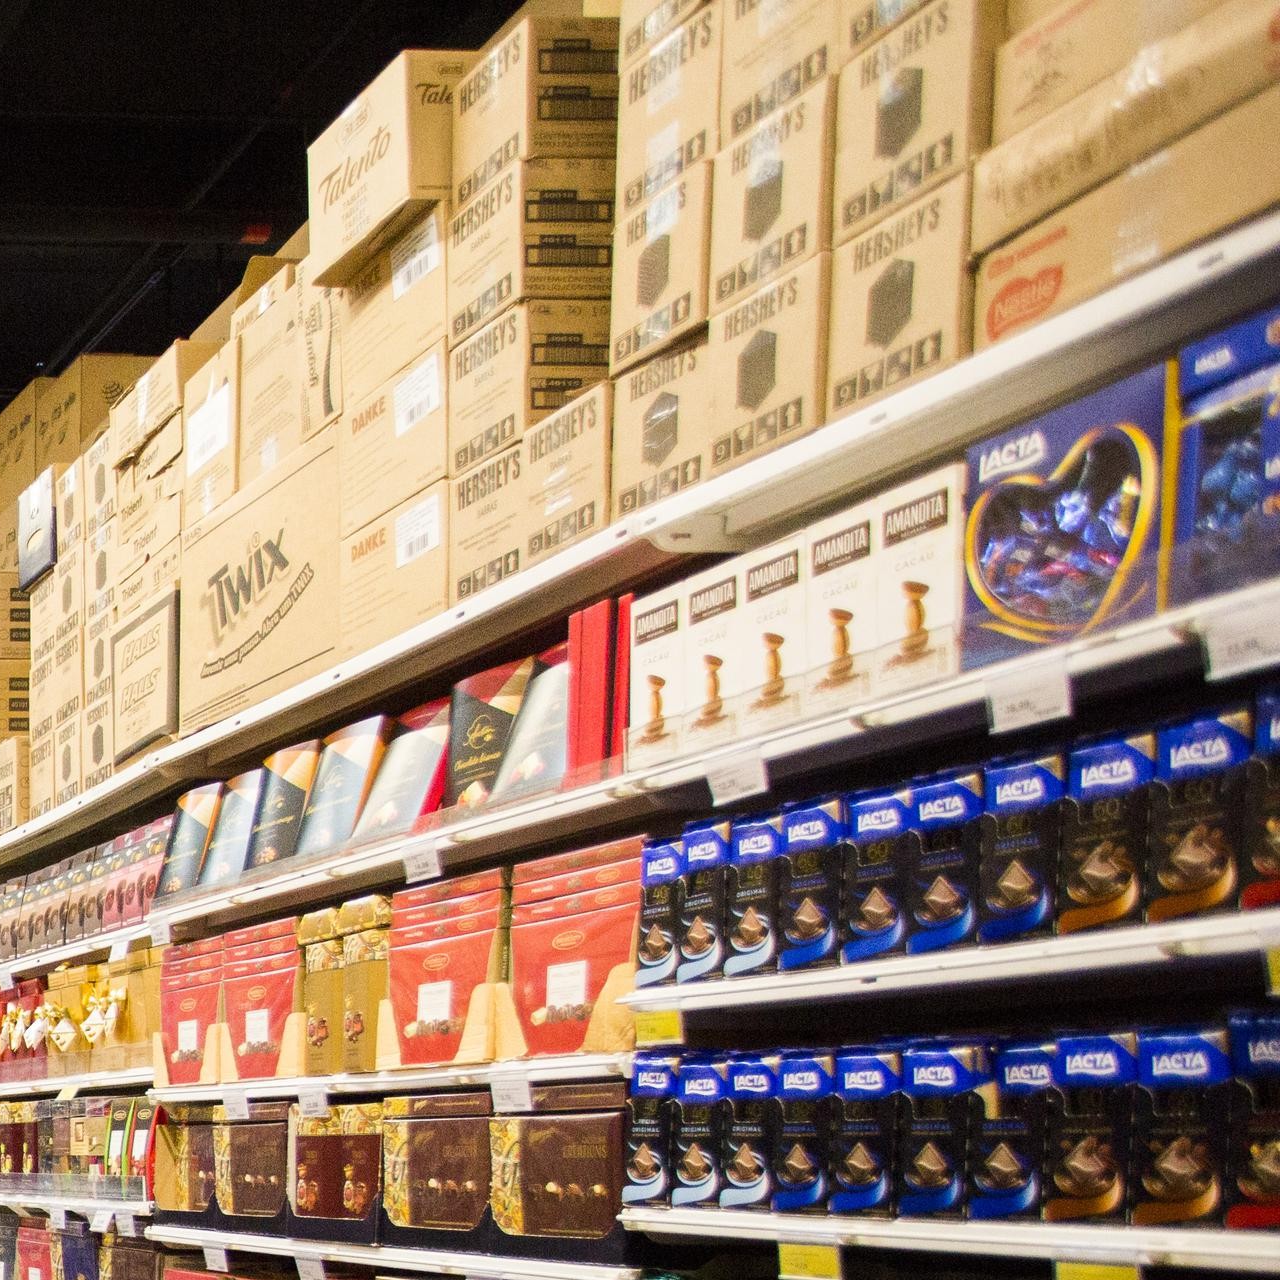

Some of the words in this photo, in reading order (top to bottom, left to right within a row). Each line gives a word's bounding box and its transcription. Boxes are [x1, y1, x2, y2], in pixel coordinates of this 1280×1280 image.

[459, 33, 521, 114] HERSHEY'S
[416, 82, 452, 106] Tale
[319, 125, 392, 214] Talento
[452, 176, 514, 255] HERSHEY'S
[853, 198, 941, 275] HERSHEY'S
[455, 314, 517, 382] HERSHEY'S
[630, 347, 697, 401] HERSHEY'S
[351, 396, 386, 434] DANKE
[529, 396, 597, 464] HERSHEY'S
[979, 431, 1047, 483] LACTA
[813, 530, 869, 566] AMANDITA
[749, 558, 797, 593] AMANDITA
[821, 580, 859, 601] CACAU
[691, 584, 735, 617] AMANDITA
[120, 624, 161, 671] HALLS
[120, 667, 160, 715] HALLS
[1170, 739, 1228, 768] LACTA
[996, 778, 1043, 804] LACTA
[1082, 760, 1135, 788] LACTA
[858, 809, 899, 832] LACTA
[919, 796, 965, 820] LACTA
[739, 834, 772, 855] LACTA
[788, 820, 824, 843] LACTA
[647, 857, 675, 877] LACTA
[688, 841, 718, 863] LACTA
